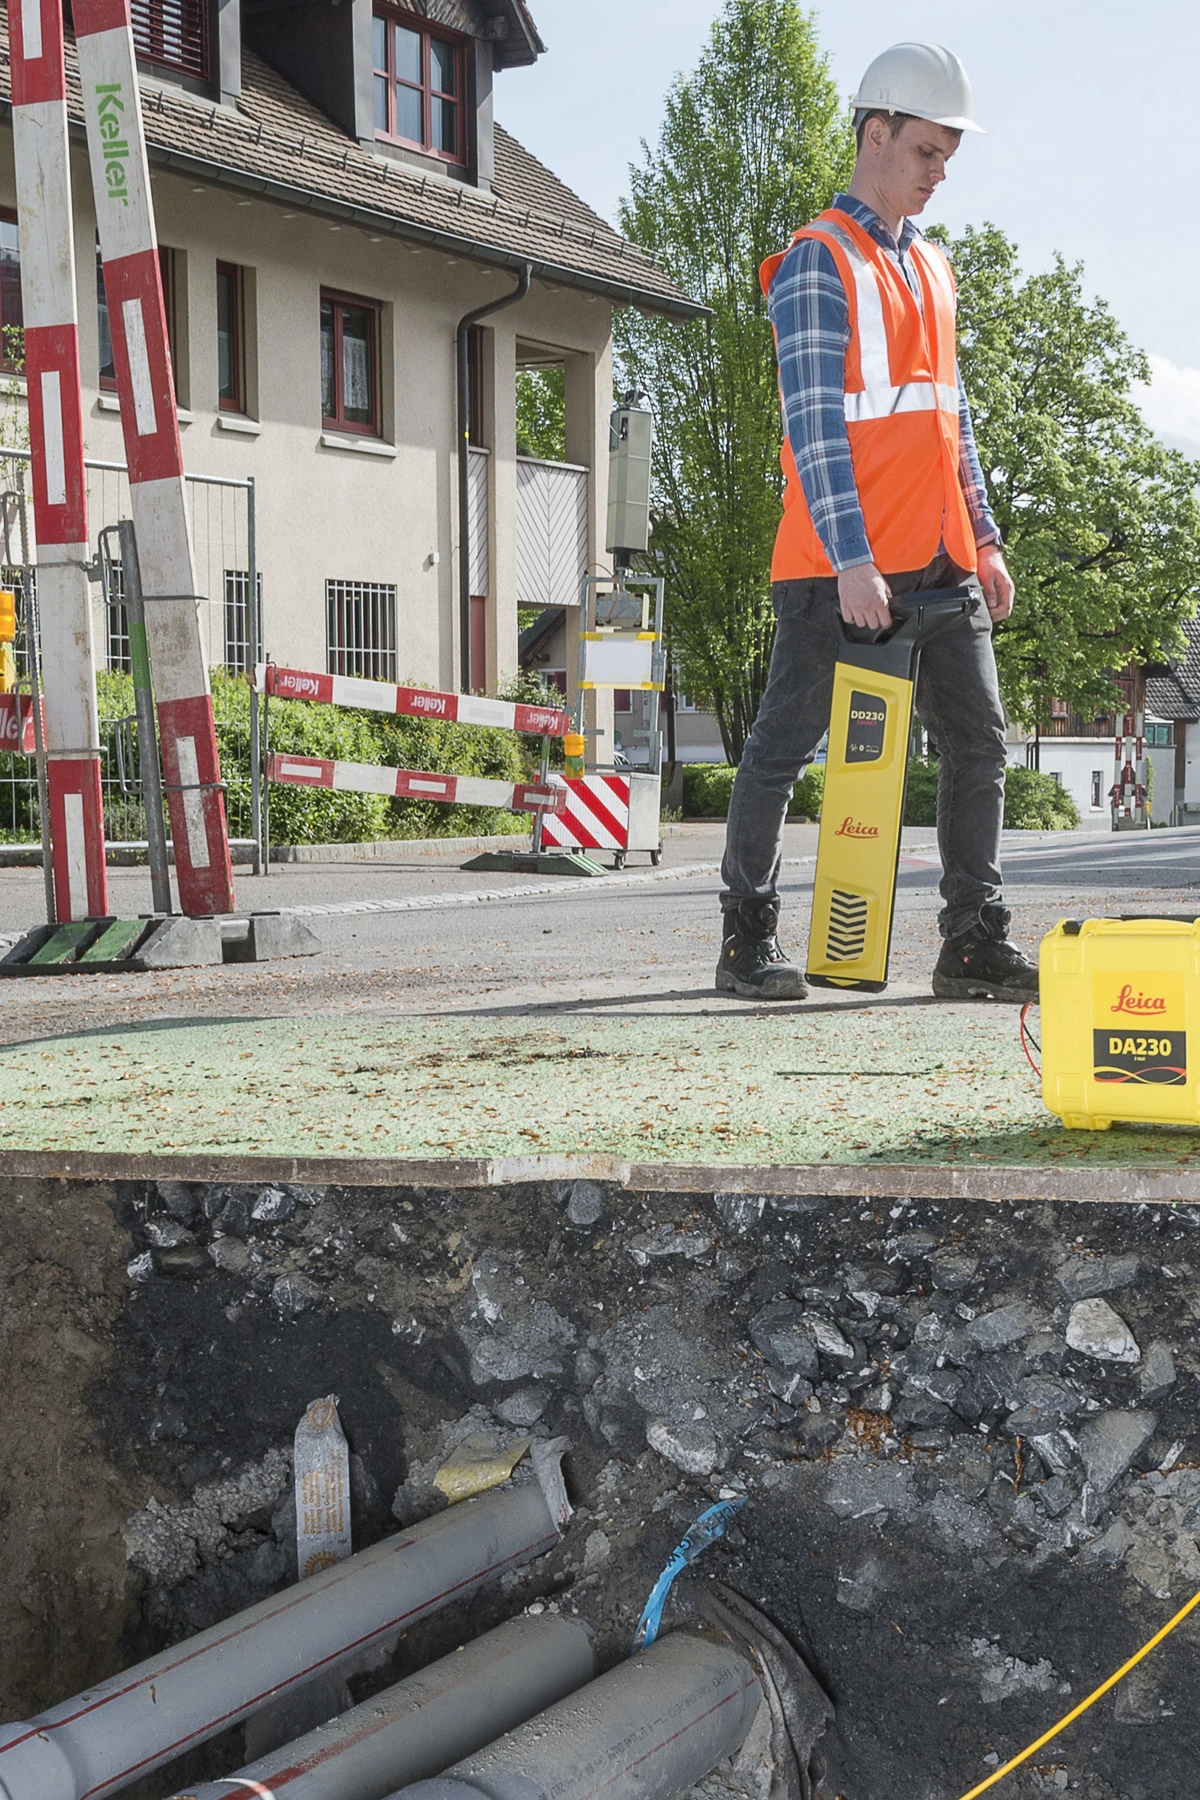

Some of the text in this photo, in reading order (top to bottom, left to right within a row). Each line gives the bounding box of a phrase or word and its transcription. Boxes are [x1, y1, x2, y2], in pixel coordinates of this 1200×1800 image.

[95, 83, 128, 206] Keller
[280, 675, 319, 696] Keller
[411, 695, 446, 713] Keller
[526, 712, 558, 730] Keller
[850, 710, 885, 721] DD230
[834, 816, 879, 839] Leica
[1110, 984, 1167, 1016] Leica
[1108, 1037, 1172, 1057] DA230
